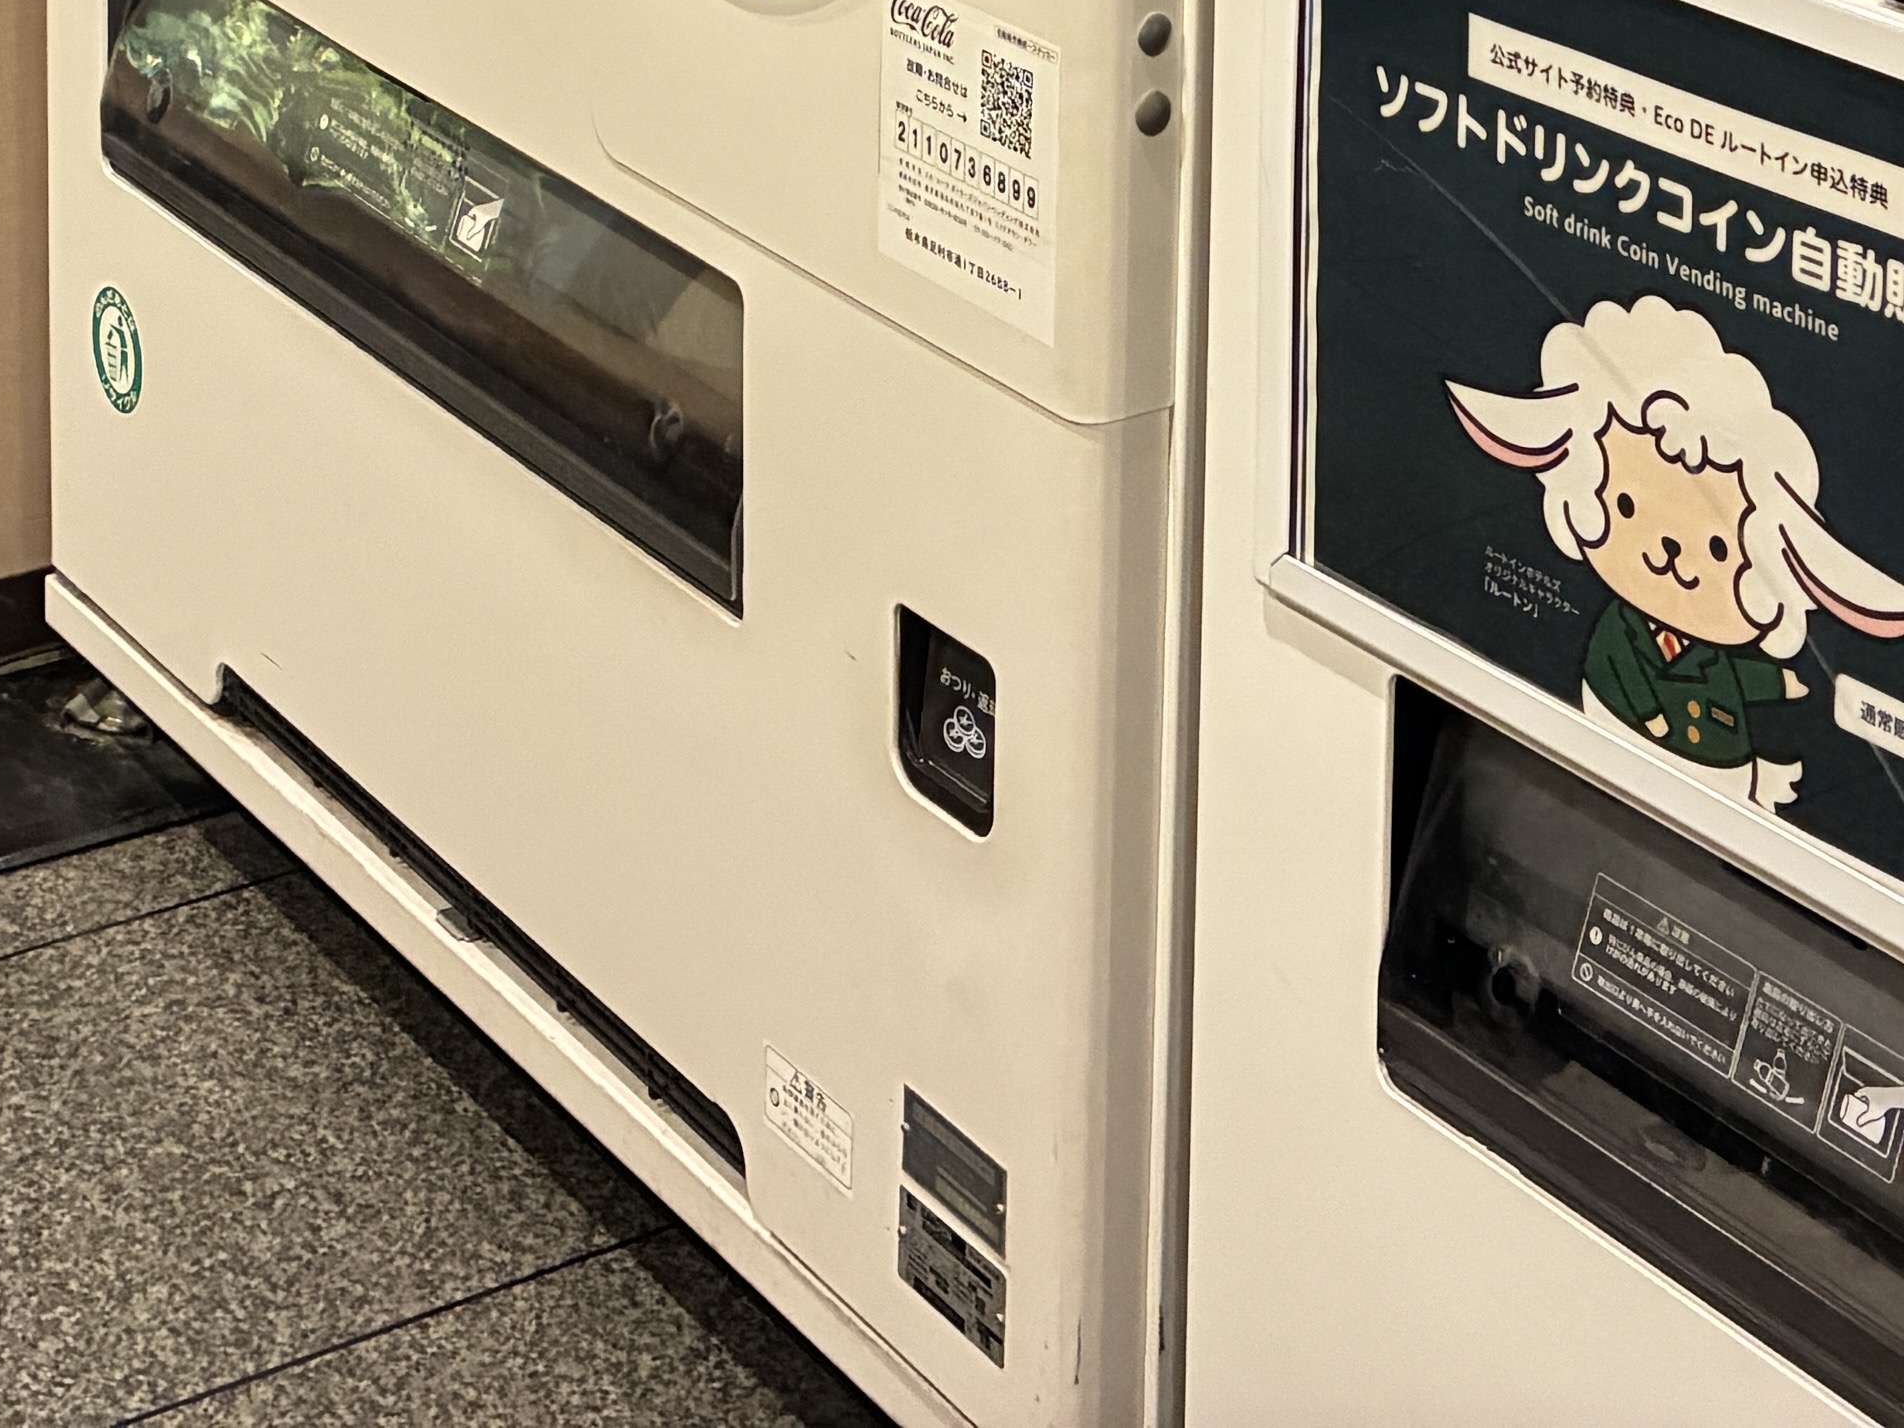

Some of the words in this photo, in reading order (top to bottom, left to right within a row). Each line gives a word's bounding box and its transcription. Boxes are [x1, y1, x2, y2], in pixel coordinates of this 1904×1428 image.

[1690, 119, 1714, 144] DE
[1721, 130, 1888, 210] ルートイン申込特典
[1524, 196, 1558, 226] Soft
[1565, 214, 1611, 250] drink
[1617, 235, 1658, 269] Coin
[1666, 255, 1746, 310] Vending
[1754, 294, 1839, 341] machine
